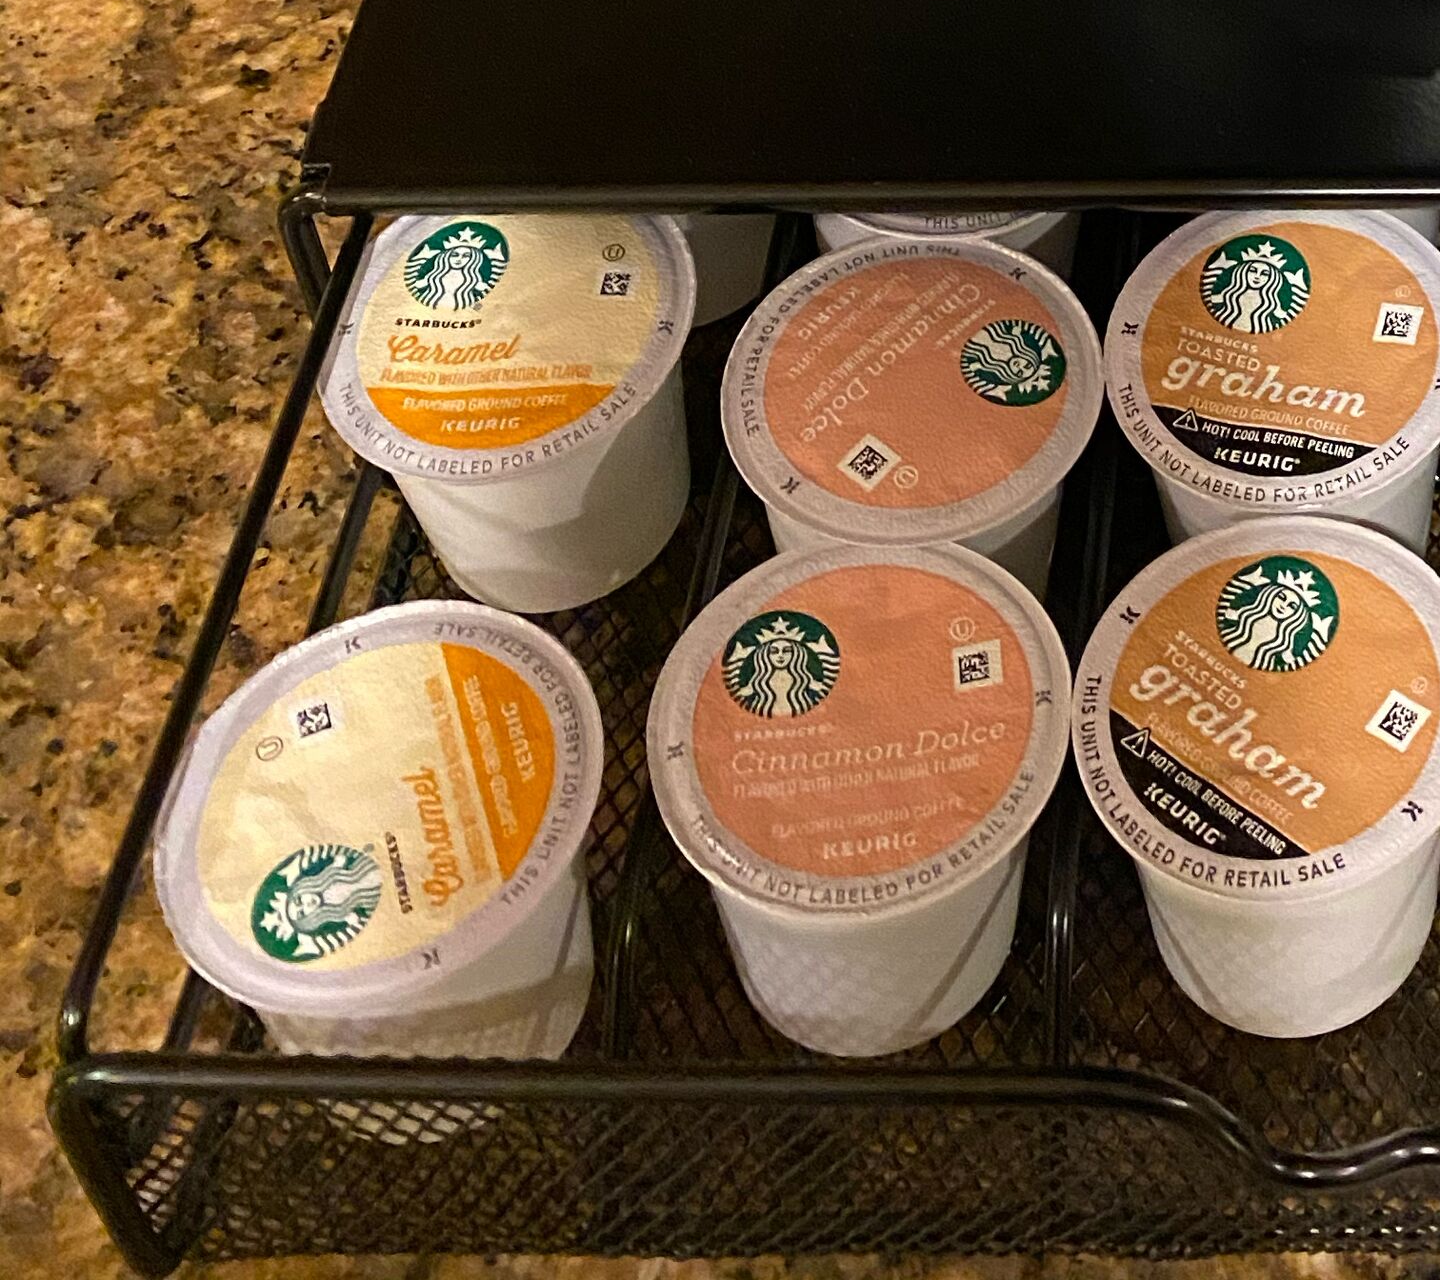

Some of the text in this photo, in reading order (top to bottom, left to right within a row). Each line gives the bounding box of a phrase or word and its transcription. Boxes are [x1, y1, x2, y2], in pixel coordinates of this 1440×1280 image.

[387, 335, 521, 364] Caramel
[1176, 339, 1261, 372] TOASTED
[800, 376, 869, 443] Dolce
[1160, 355, 1366, 418] graham
[339, 382, 637, 476] THIS UNIT NOT LABELED FOR RETAIL SALE
[1118, 383, 1411, 503] THIS UNIT NOT LABELED FOR RETAIL SALE
[1202, 422, 1355, 459] HOT! COOL BEFORE PEELING
[1163, 644, 1242, 711] TOASTED
[731, 743, 904, 777] Cinnamon
[914, 720, 1006, 756] Dolce
[1129, 664, 1328, 810] graham
[1082, 675, 1346, 889] THIS UNIT NOT LABELED FOR RETAIL SALE
[1147, 748, 1287, 857] HOT! COOL BEFORE PEELING
[401, 767, 464, 907] Caramel
[809, 883, 899, 905] LABELED
[905, 863, 943, 888] FOR
[948, 819, 1004, 866] RETAIL
[1004, 771, 1035, 816] SALE
[822, 833, 918, 860] KEURIG
